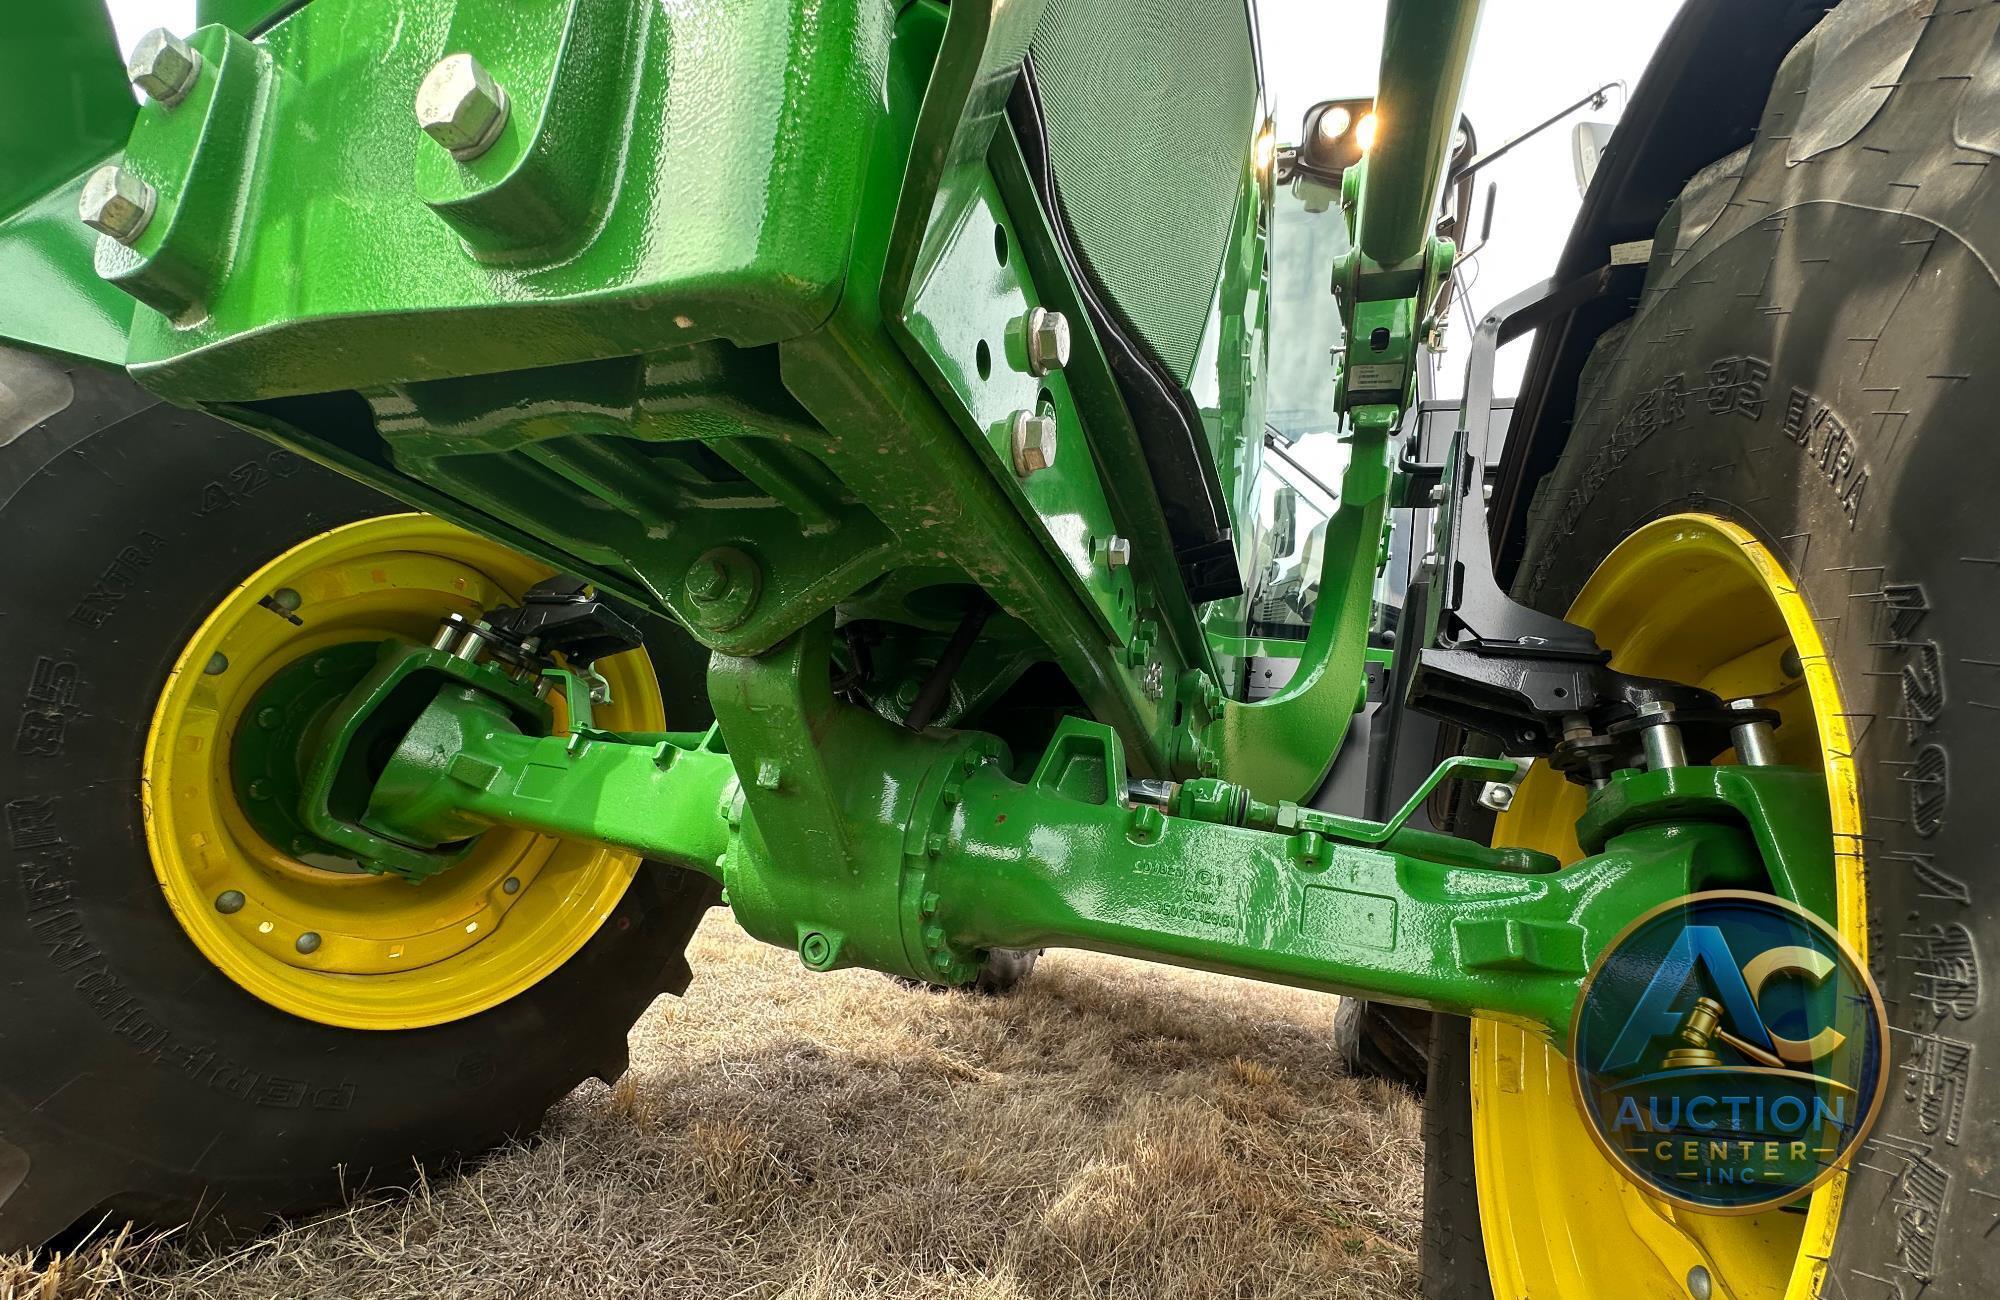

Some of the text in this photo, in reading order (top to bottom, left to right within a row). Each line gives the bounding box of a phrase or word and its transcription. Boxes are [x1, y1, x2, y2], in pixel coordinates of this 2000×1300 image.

[1783, 386, 1871, 531] EXTRA
[14, 655, 83, 757] 85
[67, 530, 168, 631] EXTRA
